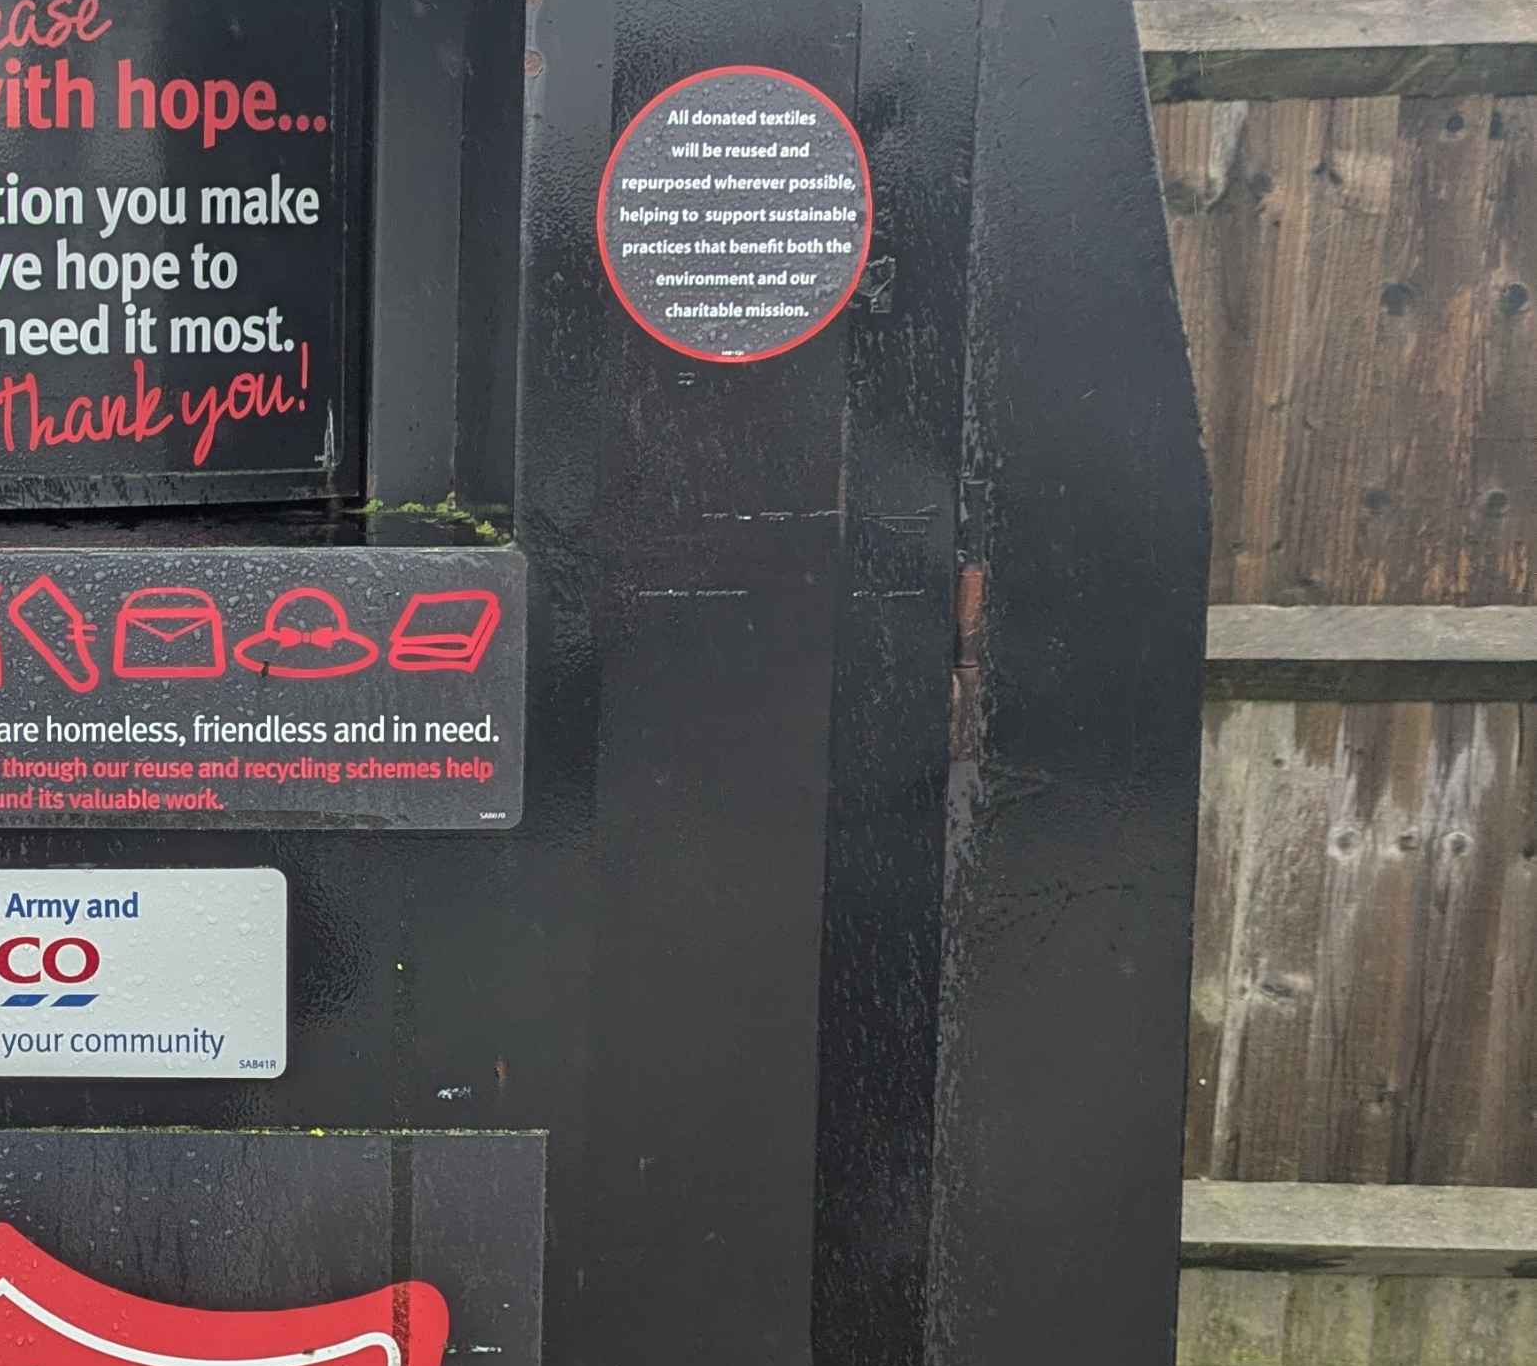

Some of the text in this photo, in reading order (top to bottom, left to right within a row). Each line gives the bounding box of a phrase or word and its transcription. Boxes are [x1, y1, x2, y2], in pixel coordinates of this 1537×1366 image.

[117, 58, 326, 149] hope...
[666, 109, 817, 126] All donated textiles
[671, 141, 811, 158] will be reused and
[621, 173, 856, 194] repurposed wherever possible,
[95, 186, 187, 239] you
[201, 173, 320, 225] make
[619, 206, 857, 226] helping to support sustainable
[622, 237, 852, 258] practices that benefit both the
[56, 239, 181, 305] hope
[190, 242, 238, 290] to
[655, 270, 818, 287] environment and our
[664, 301, 810, 318] charitable mission.
[124, 303, 158, 354] it
[170, 306, 295, 354] most.
[180, 342, 309, 467] you!
[46, 714, 186, 747] homeless,
[193, 714, 328, 743] friendless
[333, 714, 385, 743] and
[393, 714, 417, 743] in
[425, 714, 500, 743] need.
[1, 756, 89, 784] through
[91, 762, 130, 780] our
[133, 762, 195, 780] reuse
[197, 757, 240, 780] and
[242, 756, 343, 785] recycling
[344, 757, 443, 780] schemes
[444, 756, 495, 783] help
[37, 788, 65, 811] its
[68, 788, 161, 812] valuable
[164, 788, 223, 811] work.
[4, 892, 80, 926] Army
[86, 891, 139, 919] and
[1, 1033, 65, 1059] your
[70, 1027, 225, 1060] community
